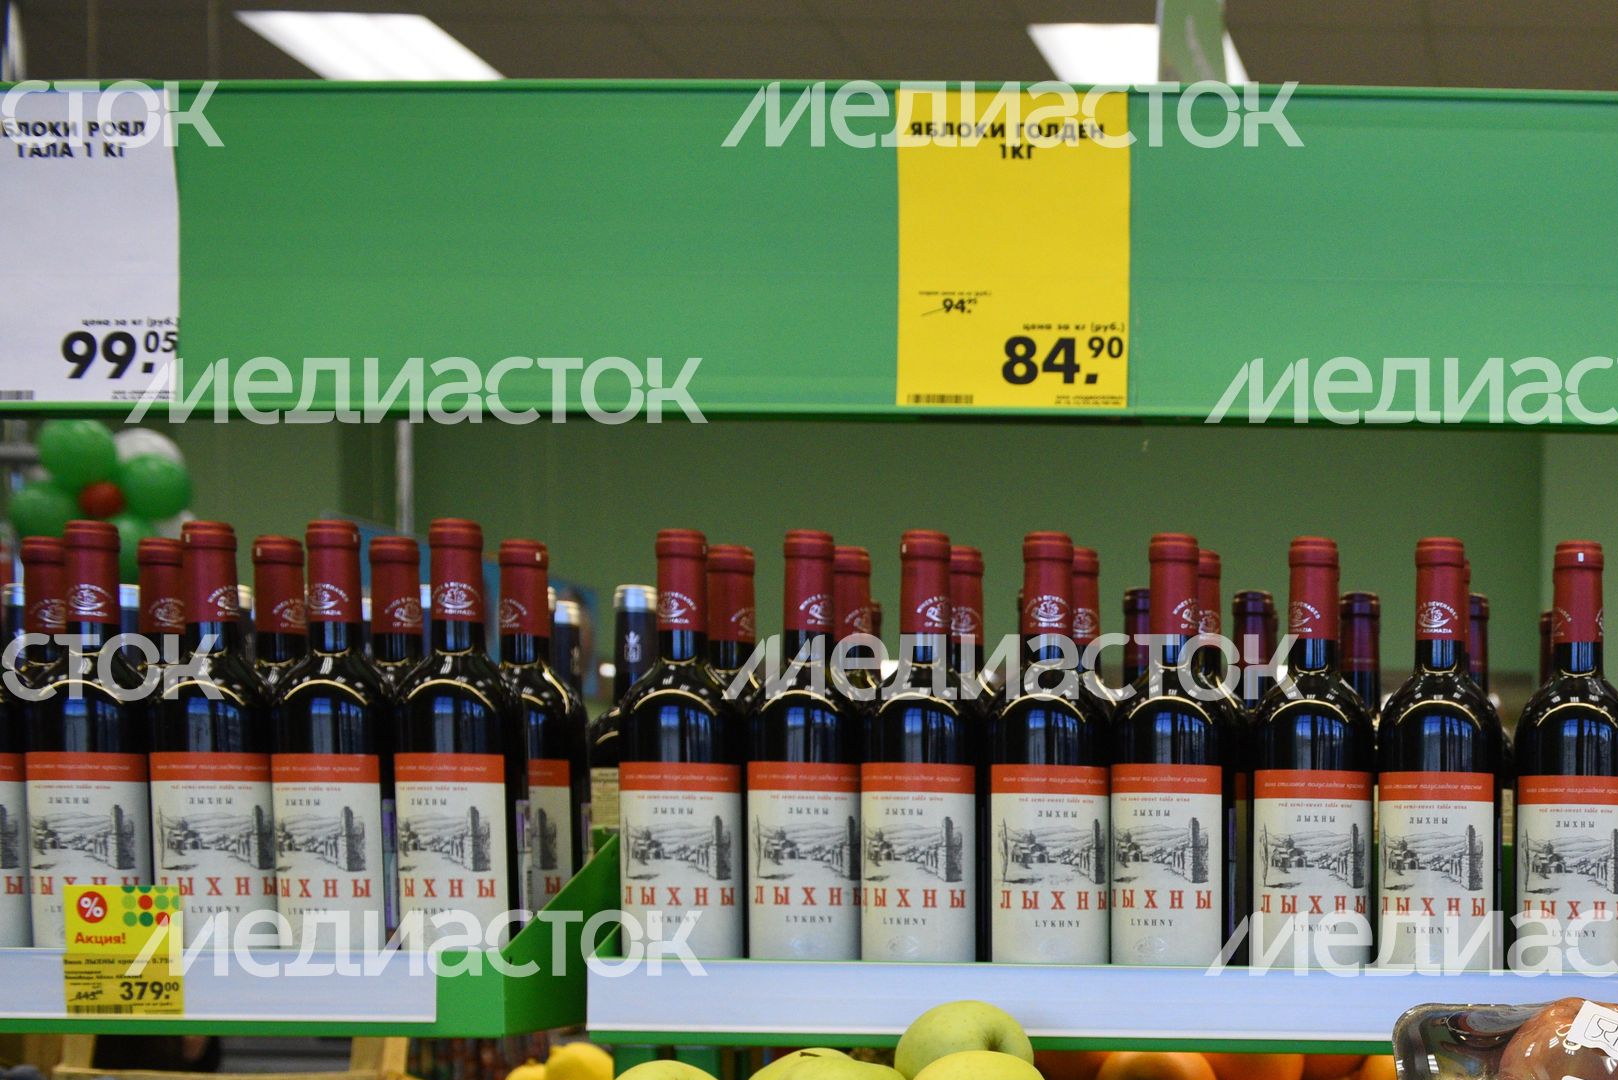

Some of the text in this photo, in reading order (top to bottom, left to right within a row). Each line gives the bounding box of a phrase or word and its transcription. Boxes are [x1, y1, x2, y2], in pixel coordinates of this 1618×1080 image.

[1, 121, 77, 137] БЛОКИ
[910, 121, 1105, 142] ЯБЛОКИ ГОЛДЕН
[84, 142, 93, 157] 1
[103, 142, 126, 157] КГ
[999, 144, 1037, 159] 1КГ
[1022, 322, 1053, 332] цена
[625, 886, 735, 906] ЛЫХНЫ
[1000, 890, 1108, 910] ЛЫХНЫ
[1260, 894, 1367, 914] ЛЫХНЫ
[1381, 896, 1485, 917] ЛЫХНЫ
[785, 914, 833, 924] LYKHNY
[883, 917, 927, 926] LYKHNY
[1035, 919, 1081, 928] LYKHNY
[1130, 917, 1174, 927] LYKHNY
[74, 931, 127, 946] Акция!
